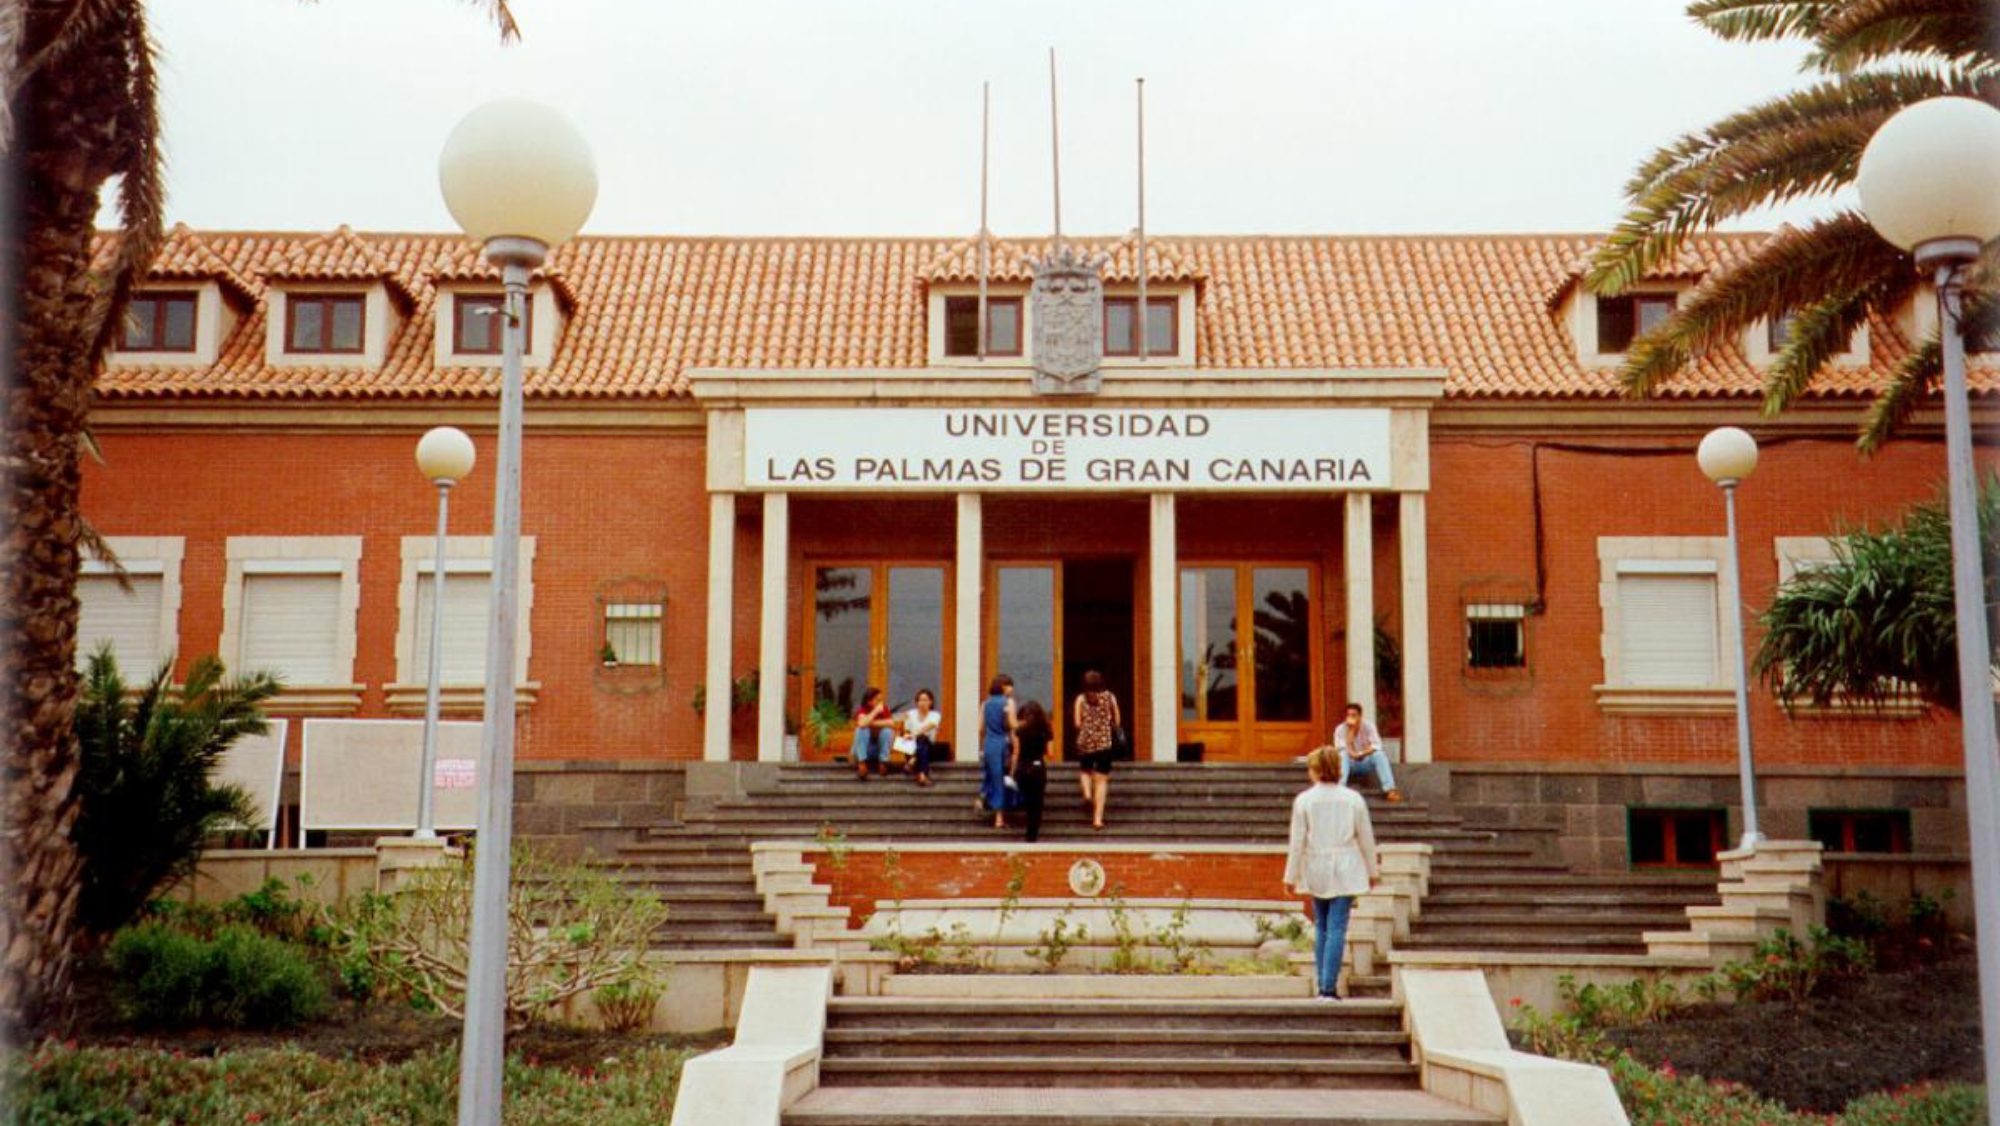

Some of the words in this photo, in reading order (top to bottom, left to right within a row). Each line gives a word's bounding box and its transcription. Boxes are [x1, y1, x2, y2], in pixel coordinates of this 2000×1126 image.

[946, 414, 1210, 437] UNIVERSIDAD
[1031, 440, 1065, 455] DE
[767, 457, 836, 481] LAS
[854, 458, 1002, 482] PALMAS
[1019, 458, 1067, 481] DE
[1086, 458, 1190, 482] GRAN
[1207, 458, 1372, 482] CANARIA
